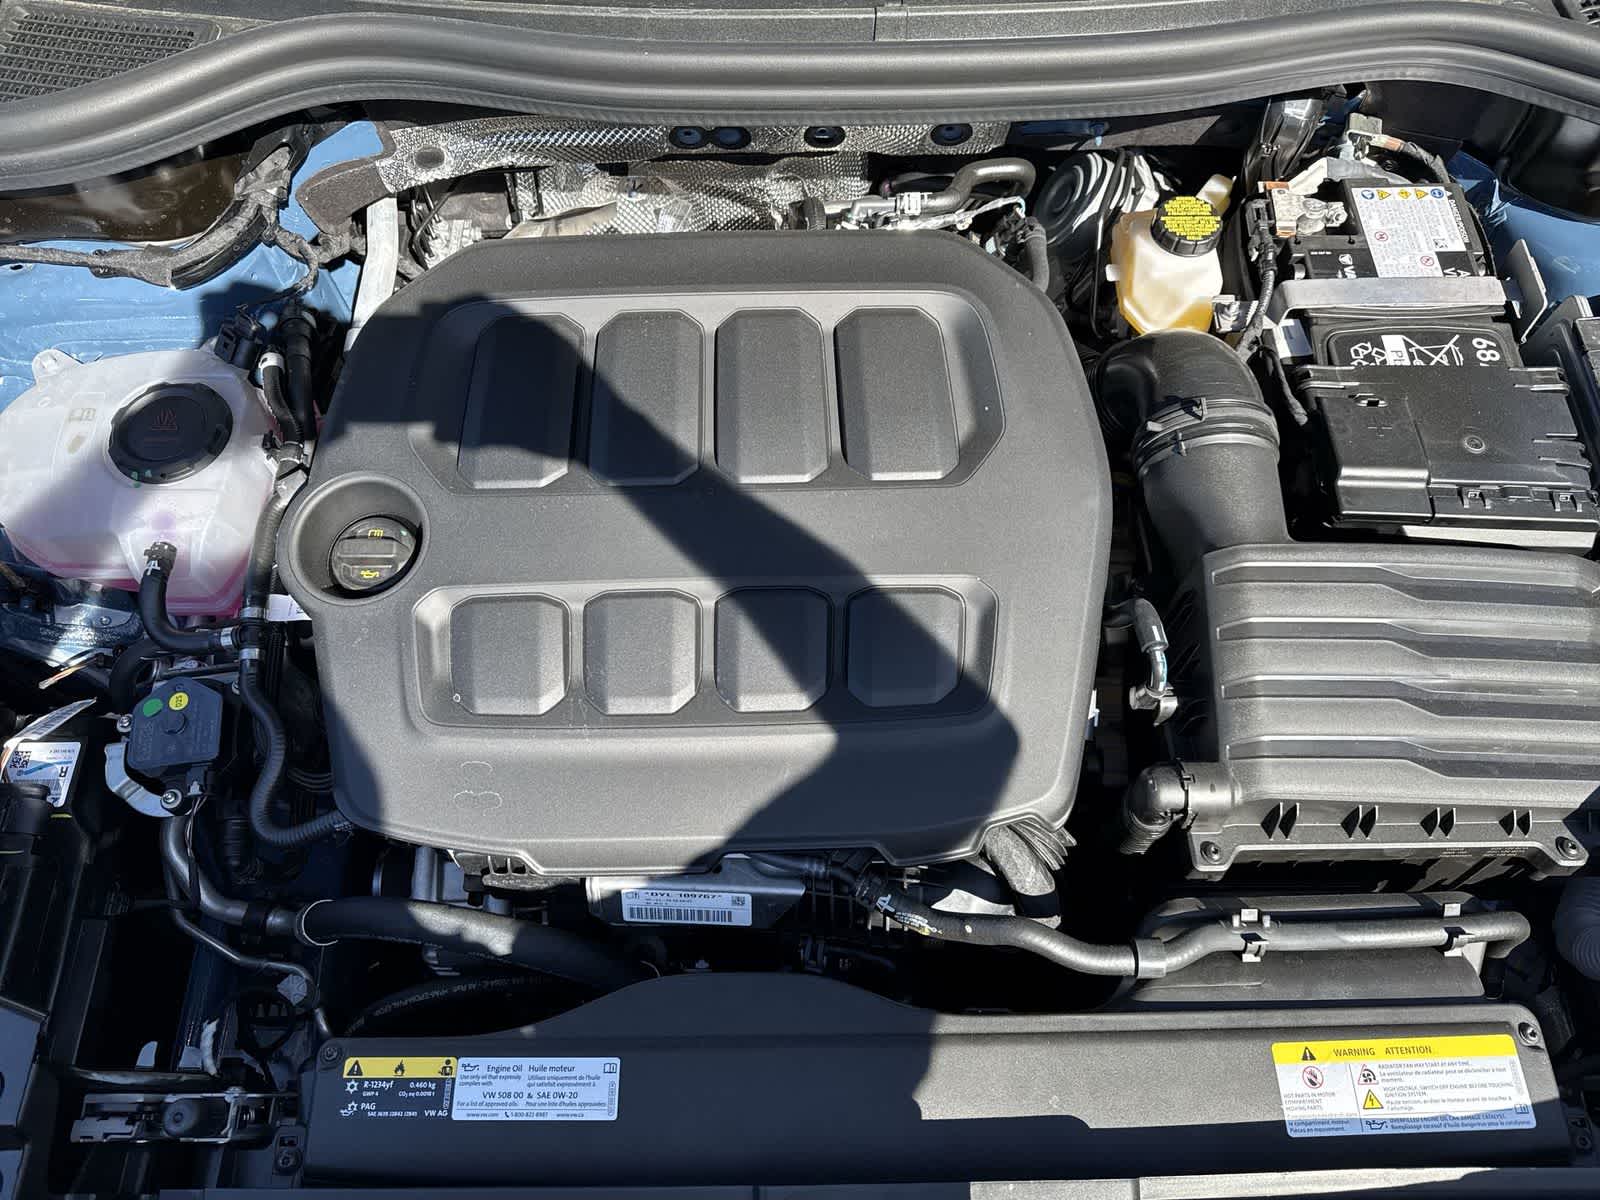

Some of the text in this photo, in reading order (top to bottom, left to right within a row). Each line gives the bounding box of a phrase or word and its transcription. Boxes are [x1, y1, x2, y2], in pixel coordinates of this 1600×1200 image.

[1333, 1045, 1432, 1057] WARNING ATTENTION
[487, 1064, 523, 1073] Engine Oil
[528, 1064, 576, 1072] Huile moteur
[363, 1080, 436, 1090] R-1234yf 0.460 kg
[482, 1091, 497, 1099] VW
[498, 1091, 512, 1099] 508
[513, 1091, 524, 1099] 00
[536, 1091, 552, 1099] SAE
[552, 1091, 578, 1099] 0W-20
[360, 1102, 376, 1110] PAG
[424, 1109, 448, 1117] VW AG
